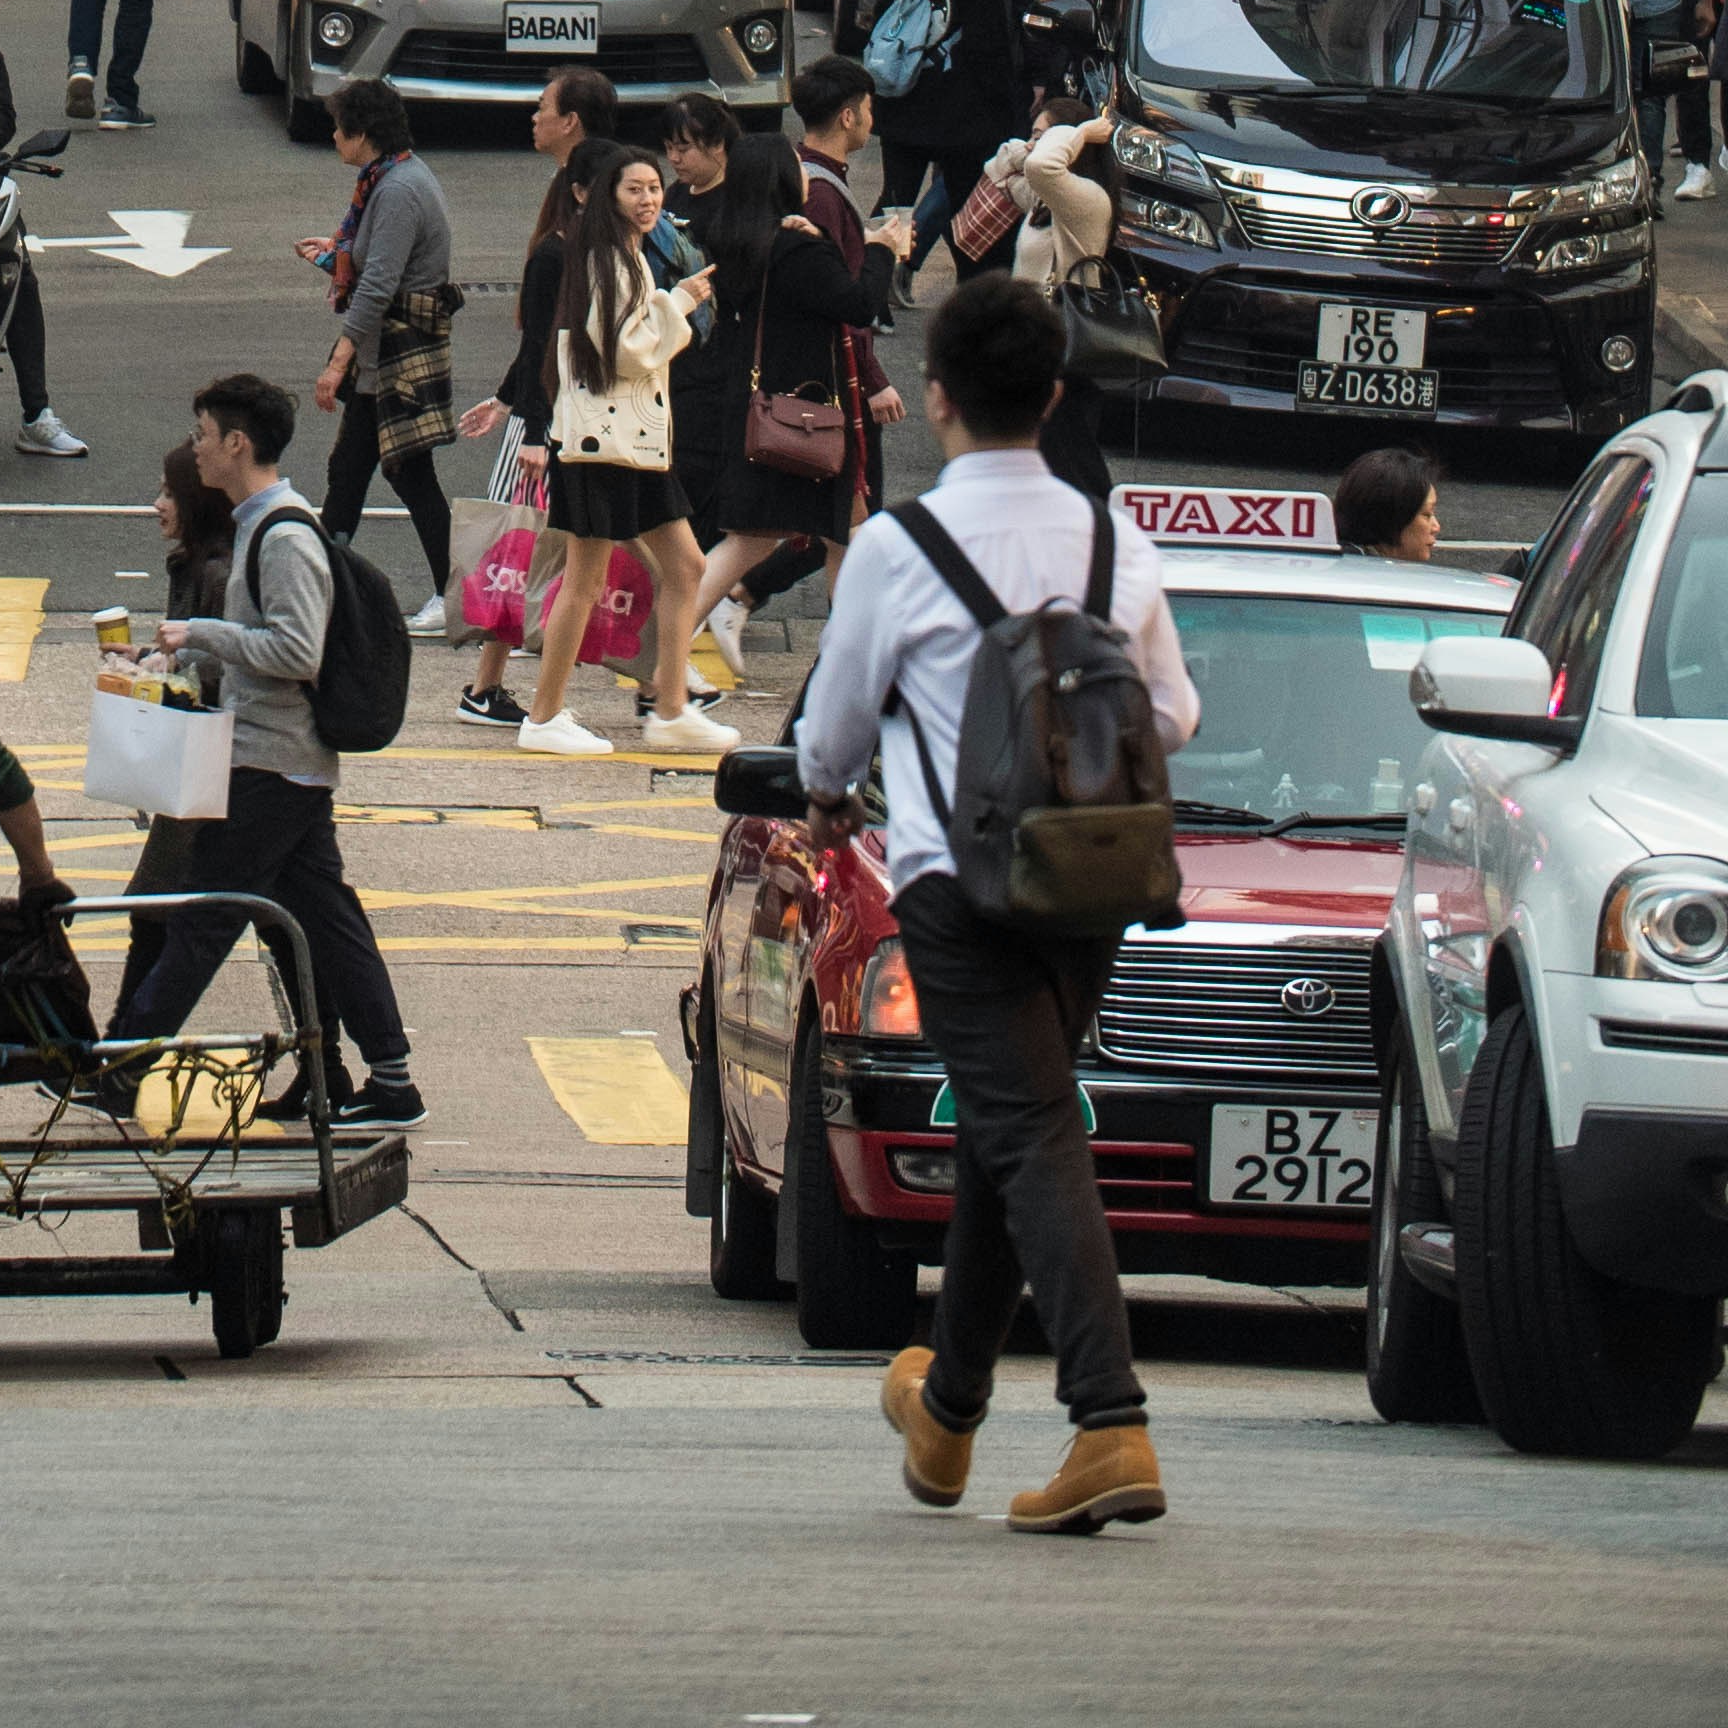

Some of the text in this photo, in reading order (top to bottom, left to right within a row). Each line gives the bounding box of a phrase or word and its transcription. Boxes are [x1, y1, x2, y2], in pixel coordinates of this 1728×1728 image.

[507, 17, 598, 42] BABAN1
[1349, 308, 1394, 337] RE
[1343, 337, 1400, 366] 190
[1123, 491, 1316, 537] TAXI
[1265, 1109, 1341, 1157] BZ
[1232, 1155, 1372, 1205] 2912
